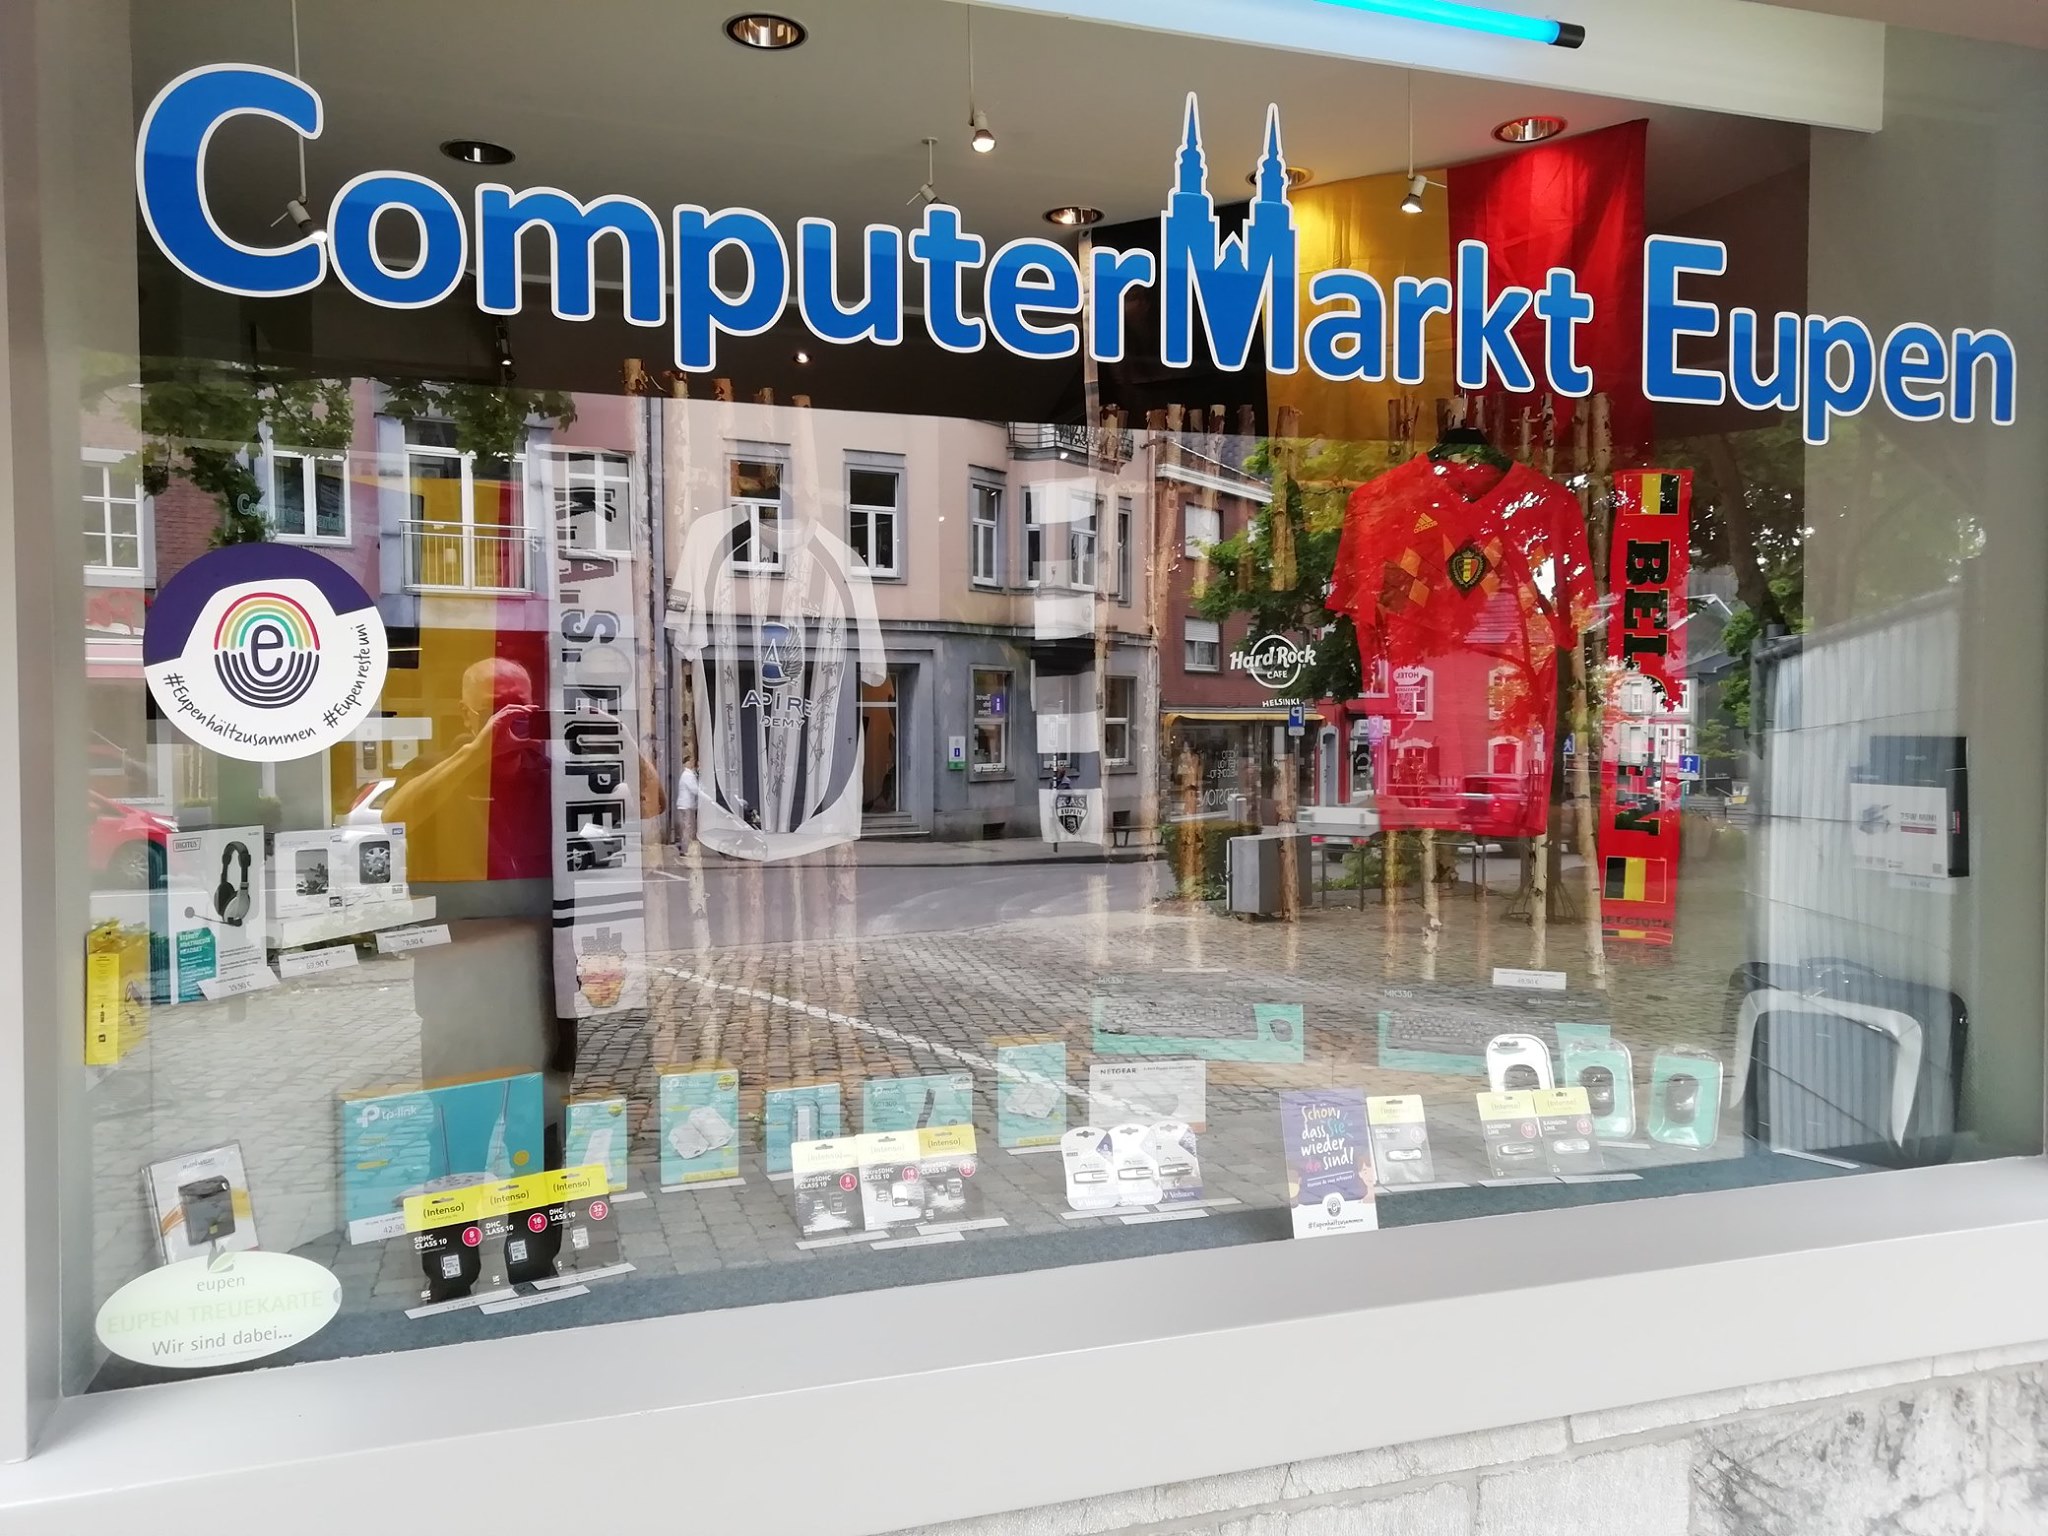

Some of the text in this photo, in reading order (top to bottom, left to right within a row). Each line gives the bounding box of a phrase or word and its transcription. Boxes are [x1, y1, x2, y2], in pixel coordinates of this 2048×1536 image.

[136, 63, 2017, 446] ComputerMarkt Eupen
[1229, 643, 1317, 670] Hard Rock
[1262, 698, 1300, 708] HELSINKI
[562, 683, 626, 872] EUPEN
[1100, 1067, 1137, 1075] NETGEAR
[1301, 1102, 1340, 1123] Schön,
[1302, 1118, 1346, 1140] dass Sie
[1301, 1133, 1346, 1157] wieder
[1323, 1146, 1354, 1171] sind!
[414, 1233, 434, 1245] SDHC
[414, 1237, 448, 1250] CLASS 10
[197, 1275, 246, 1293] eupen
[106, 1290, 324, 1335] EUPEN TREUEKARTE
[152, 1340, 185, 1356] Wir
[190, 1333, 226, 1352] sind
[232, 1325, 293, 1346] dabei...
